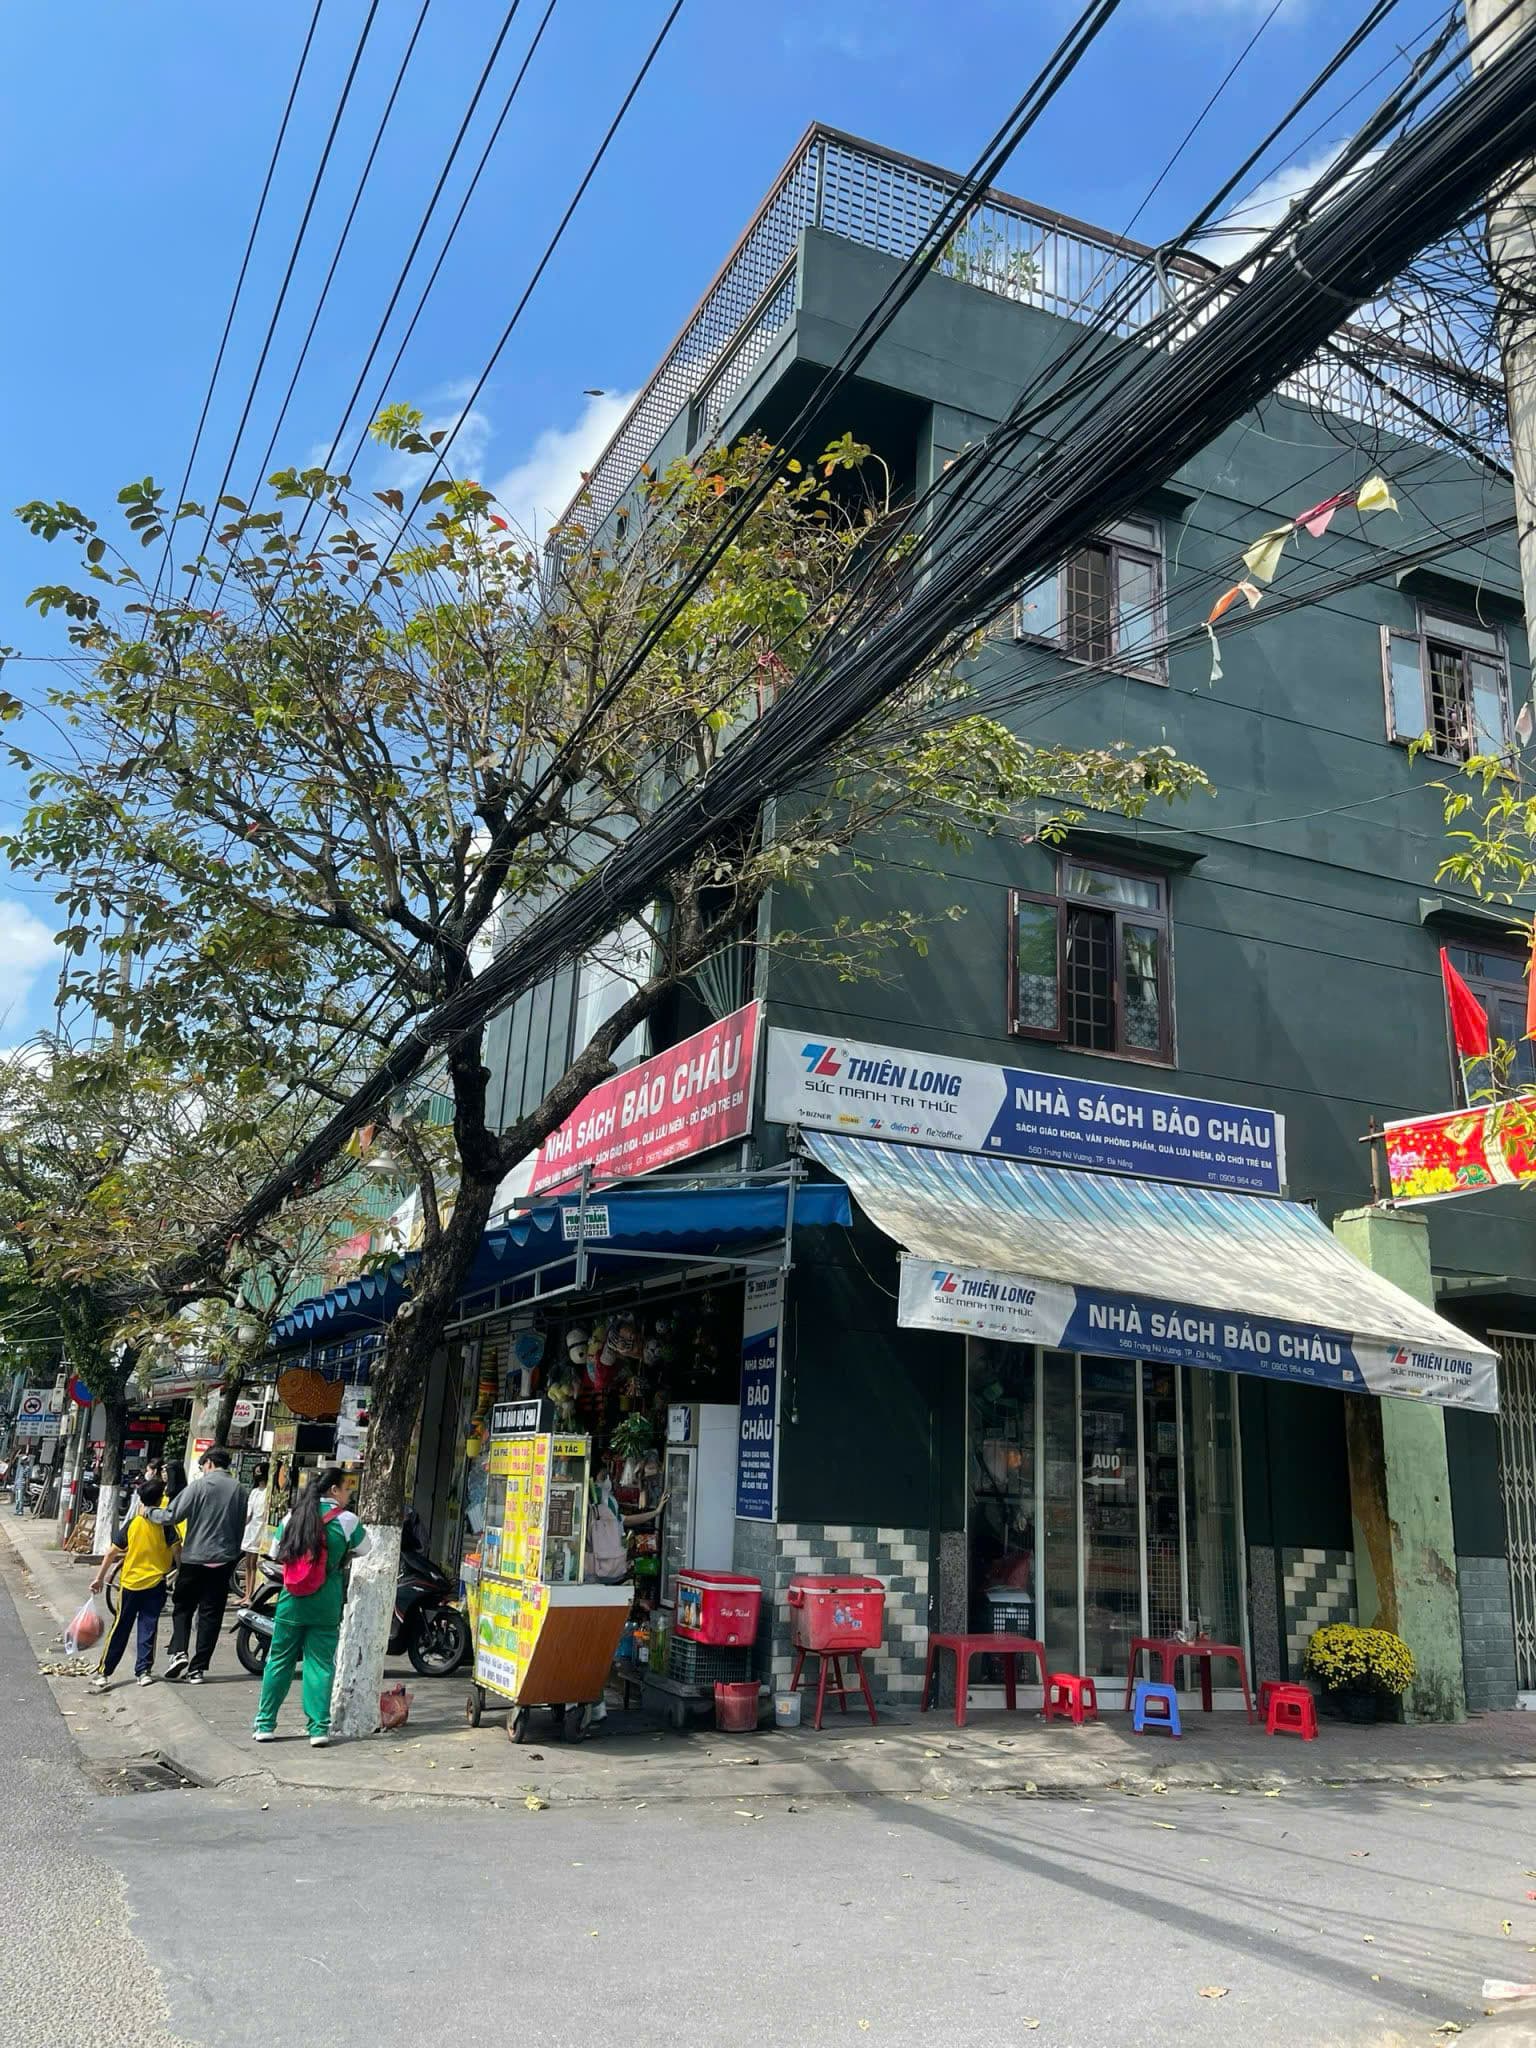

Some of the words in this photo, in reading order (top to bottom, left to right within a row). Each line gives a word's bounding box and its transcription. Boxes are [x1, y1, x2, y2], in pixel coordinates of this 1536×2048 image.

[847, 1058, 907, 1090] THIÊN
[908, 1068, 963, 1098] LONG
[545, 1120, 573, 1165] NHÀ
[576, 1106, 617, 1149] SÁCH
[621, 1071, 666, 1129] BẢO
[671, 1033, 742, 1104] CHÂU
[804, 1079, 835, 1095] SỨC
[890, 1094, 916, 1107] TRI
[919, 1096, 958, 1114] THỨC
[805, 1111, 832, 1122] BIZNER
[1015, 1087, 1070, 1118] NHÀ
[1078, 1094, 1144, 1129] SÁCH
[1152, 1105, 1200, 1138] BẢO
[1207, 1116, 1271, 1149] CHÂU
[1015, 1121, 1038, 1135] SÁCH
[1039, 1125, 1059, 1138] GIÁO
[1085, 1131, 1103, 1145] VĂN
[1103, 1133, 1131, 1149] PHÒNG
[1158, 1142, 1175, 1156] QUÀ
[1176, 1145, 1192, 1158] LƯU
[1215, 1149, 1227, 1164] ĐỒ
[1227, 1154, 1245, 1167] CHƠI
[1245, 1155, 1260, 1169] TRẺ
[1260, 1160, 1273, 1170] EM
[961, 1278, 998, 1303] THIÊN
[1000, 1285, 1036, 1306] LONG
[1088, 1303, 1143, 1335] NHÀ
[1150, 1310, 1215, 1345] SÁCH
[1223, 1321, 1271, 1355] BẢO
[1278, 1333, 1342, 1366] CHÂU
[744, 1356, 758, 1371] NHÀ
[758, 1355, 775, 1370] SÁCH
[1411, 1352, 1442, 1371] THIÊN
[1443, 1358, 1473, 1376] LONG
[747, 1379, 770, 1406] BẢO
[741, 1413, 773, 1441] CHÂU
